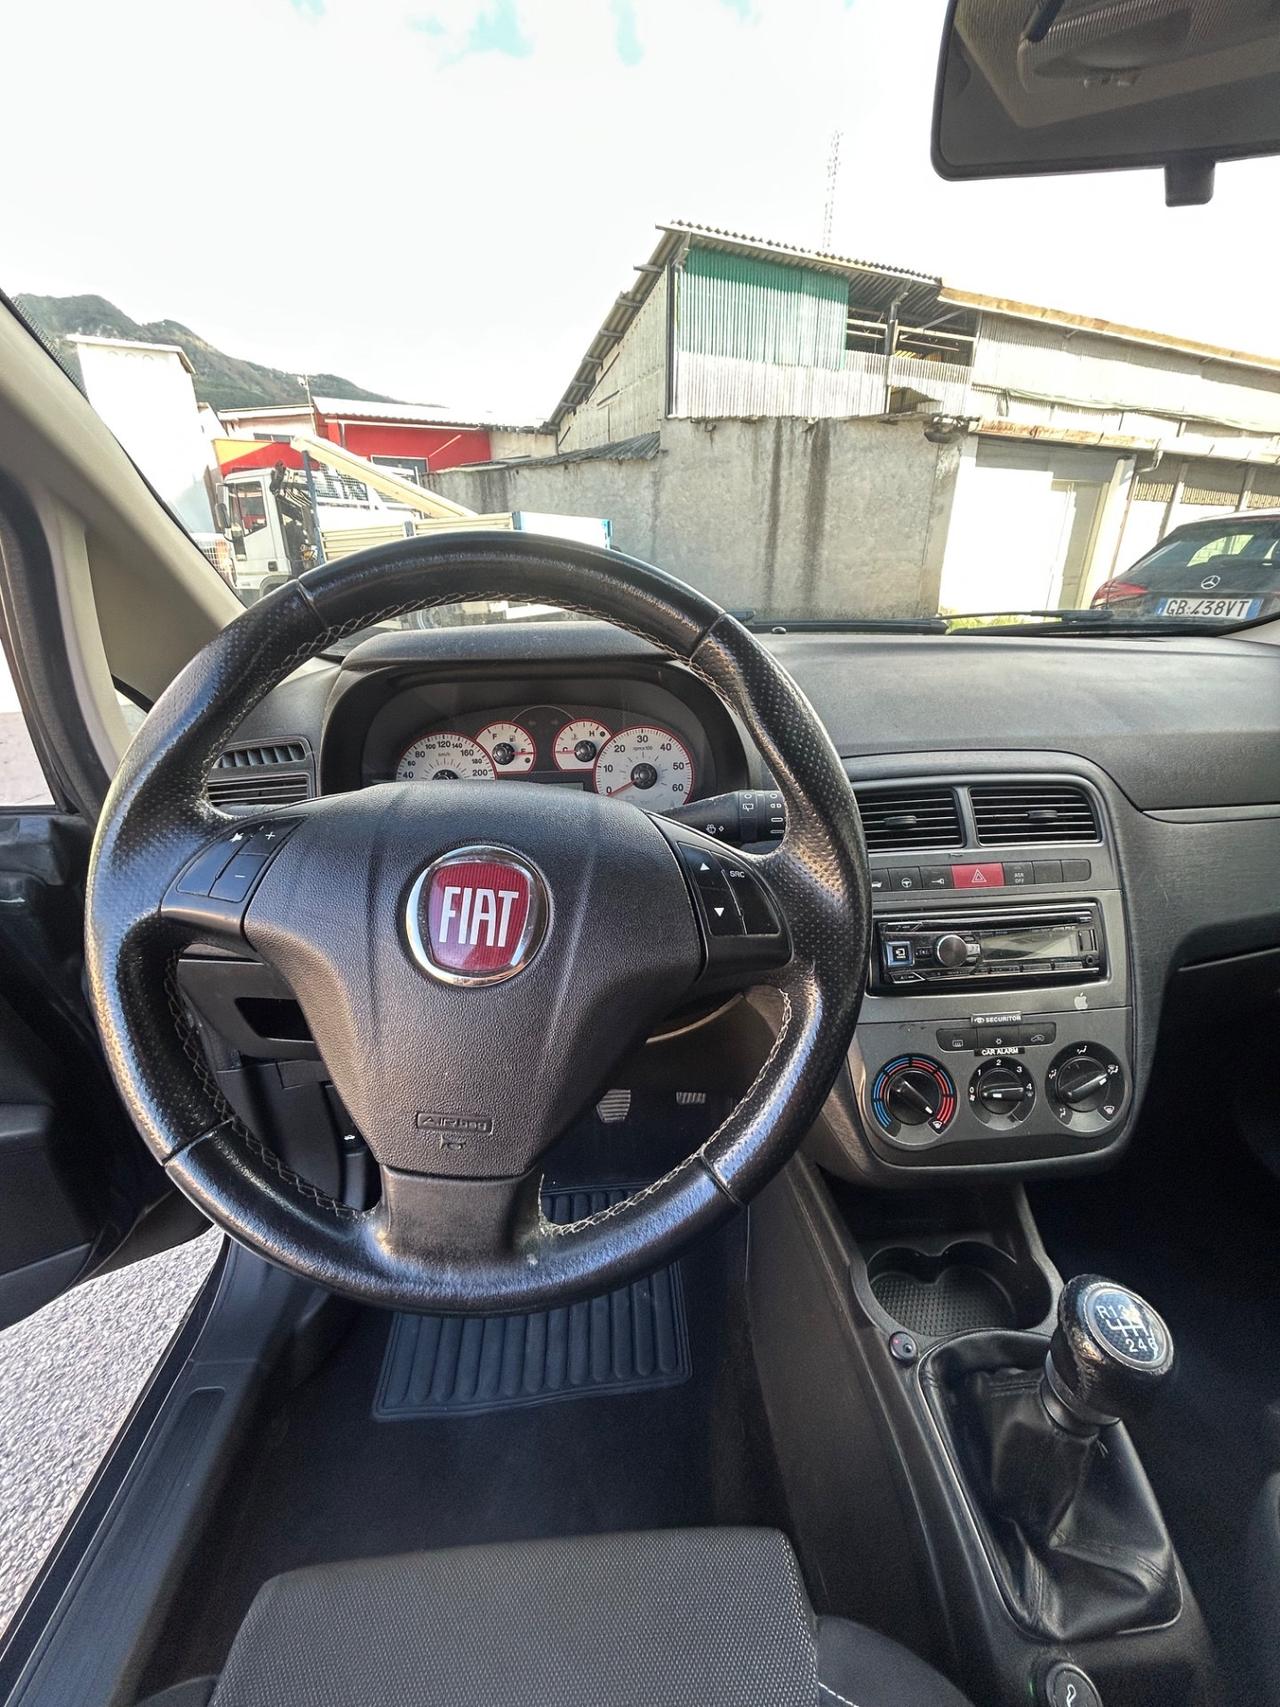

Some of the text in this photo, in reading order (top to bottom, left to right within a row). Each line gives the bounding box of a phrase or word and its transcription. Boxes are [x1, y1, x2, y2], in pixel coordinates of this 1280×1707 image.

[636, 735, 648, 743] 30
[438, 740, 451, 748] 120
[660, 743, 672, 751] 40
[614, 744, 626, 753] 20
[415, 750, 426, 758] 80
[460, 749, 474, 757] 160
[603, 764, 614, 773] 10
[672, 762, 684, 770] 50
[402, 771, 414, 779] 40
[672, 784, 684, 792] 60
[729, 870, 745, 878] SRC
[439, 886, 519, 947] FIAT
[981, 1046, 1019, 1056] CAR ALARM
